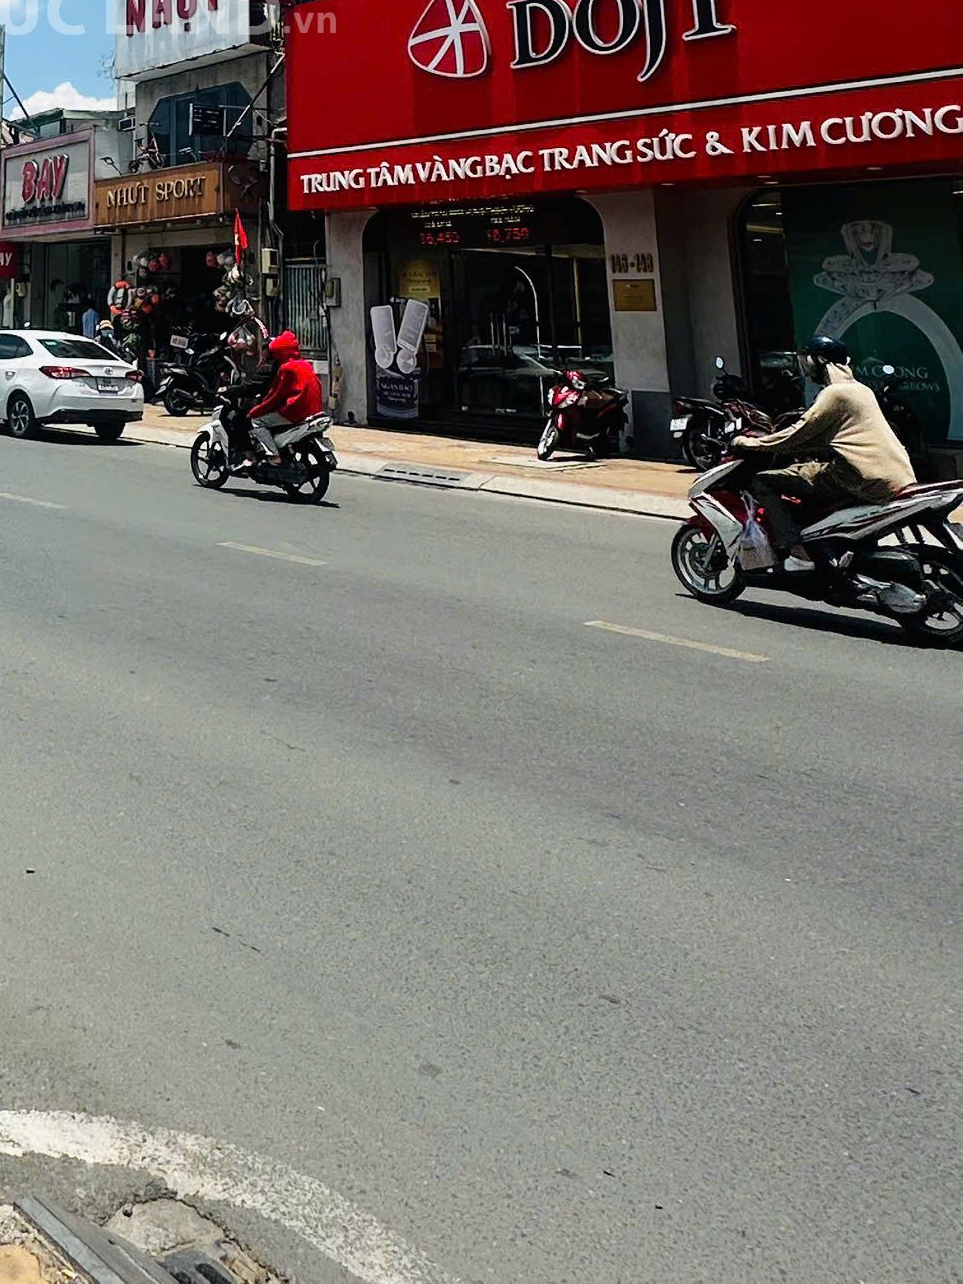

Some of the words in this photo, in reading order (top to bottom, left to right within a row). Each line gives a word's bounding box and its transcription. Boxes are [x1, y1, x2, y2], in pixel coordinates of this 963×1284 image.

[300, 169, 365, 194] TRUNG
[366, 161, 415, 188] TÂM
[414, 155, 483, 182] VÀNG
[485, 150, 536, 180] BẠC
[538, 139, 634, 171] TRANG
[636, 128, 697, 163] SỨC
[705, 131, 735, 157] &
[740, 120, 817, 153] KIM
[820, 104, 963, 146] CƯƠNG
[22, 154, 70, 204] BAY
[155, 176, 206, 202] SPORT
